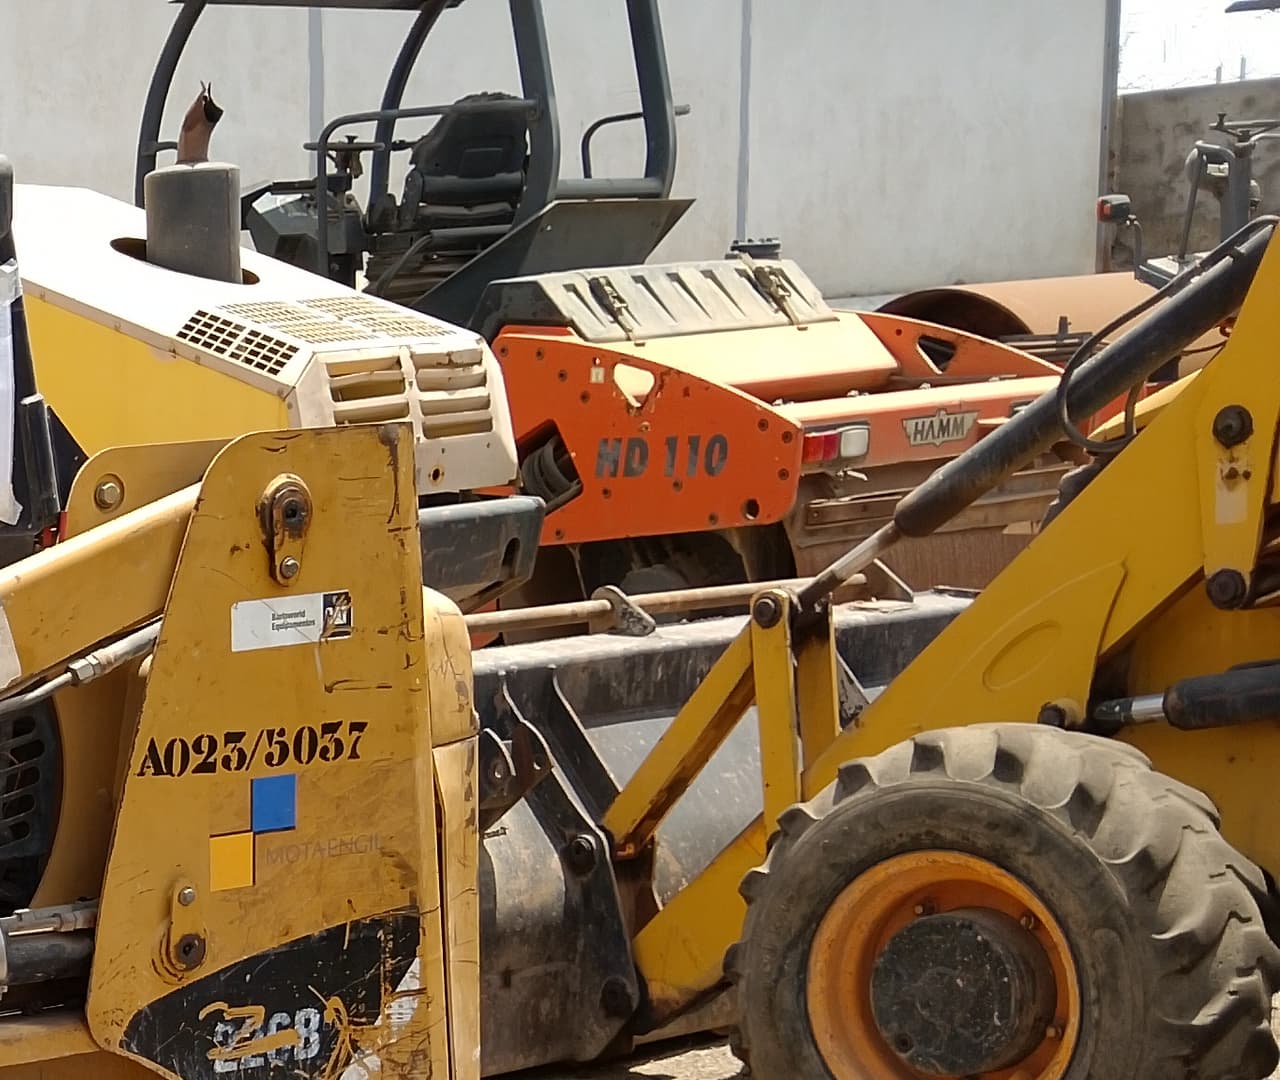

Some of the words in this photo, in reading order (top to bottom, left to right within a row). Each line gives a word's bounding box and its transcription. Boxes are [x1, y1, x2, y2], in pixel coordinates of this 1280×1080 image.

[913, 416, 965, 441] HAMM
[595, 437, 649, 478] HD
[664, 434, 728, 477] 110
[135, 721, 369, 777] A023/5037
